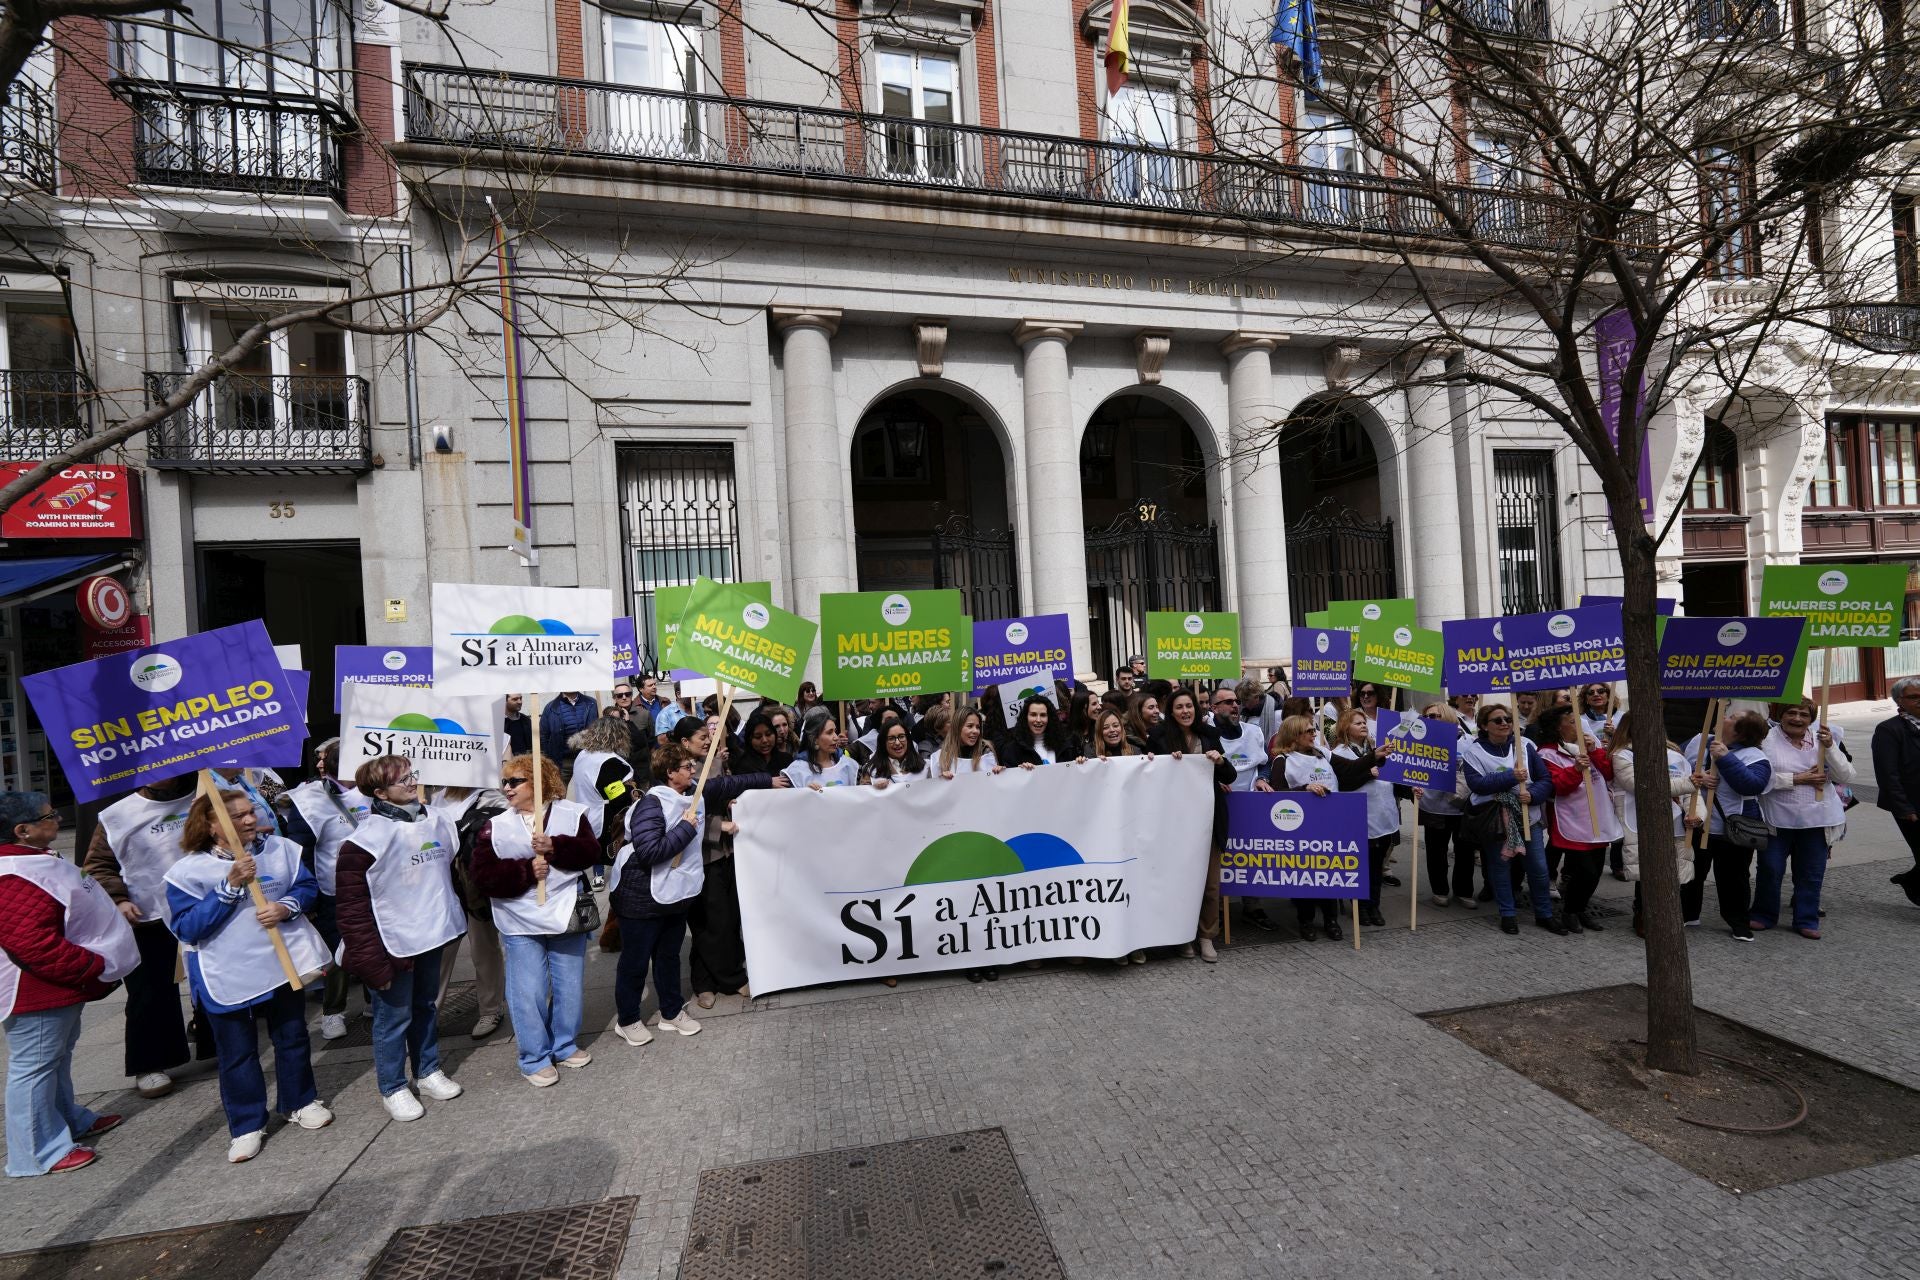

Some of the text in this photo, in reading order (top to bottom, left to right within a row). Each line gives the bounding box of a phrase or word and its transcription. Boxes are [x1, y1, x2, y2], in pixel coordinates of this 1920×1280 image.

[227, 285, 298, 299] NOTARIA
[1008, 267, 1278, 300] MINISTERIO DE IGUALDAD
[60, 470, 116, 480] CARD
[269, 501, 296, 518] 35
[1140, 505, 1157, 521] 37
[1769, 601, 1893, 610] MUJERES POR LA
[696, 613, 796, 665] MUJERES
[1810, 625, 1890, 636] LMARAZ
[92, 639, 145, 648] ACCESORIOS
[838, 628, 951, 653] MUJERES
[1157, 638, 1232, 650] MUJERES
[1508, 636, 1623, 658] MUJERES POR LA
[461, 638, 498, 667] Sí
[506, 642, 516, 652] a
[522, 638, 598, 653] Almaraz,
[506, 652, 582, 666] al futuro
[690, 631, 723, 652] POR
[723, 645, 793, 678] ALMARAZ
[838, 649, 951, 669] POR ALMARAZ
[975, 649, 1066, 668] SIN EMPLEO
[1158, 651, 1232, 660] POR ALMARAZ
[1366, 643, 1435, 666] MUJERES
[1510, 647, 1624, 670] CONTINUIDAD
[1667, 654, 1784, 667] SIN EMPLEO
[717, 661, 758, 683] 4.000
[976, 663, 1066, 678] NO HAY IGUALDAD
[1181, 664, 1210, 672] 4.000
[1297, 660, 1347, 672] SIN EMPLEO
[1364, 656, 1434, 676] POR ALMARAZ
[1459, 663, 1488, 673] POR
[1512, 659, 1626, 683] DE ALMARAZ
[1664, 669, 1780, 678] NO HAY IGUALDAD
[344, 674, 399, 683] MUJERES
[876, 672, 921, 687] 4.000
[1384, 672, 1411, 683] 4.000
[70, 680, 274, 749] SIN EMPLEO
[80, 701, 282, 767] NO HAY IGUALDAD
[363, 732, 488, 756] Sí a Almaraz,
[1385, 737, 1449, 761] MUJERES
[91, 724, 290, 786] MUJERES DE ALMARAZ POR LA CONTINUIDAD
[402, 746, 472, 763] al futuro
[1405, 756, 1448, 771] ALMARAZ
[1403, 769, 1429, 782] 4.000
[1299, 840, 1334, 852] POR
[1338, 841, 1359, 852] LA
[411, 852, 424, 866] Sí
[1220, 852, 1359, 870] CONTINUIDAD
[1220, 869, 1359, 888] DE ALMARAZ
[840, 878, 1130, 965] Sí a Almaraz,
[937, 915, 1100, 955] al futuro
